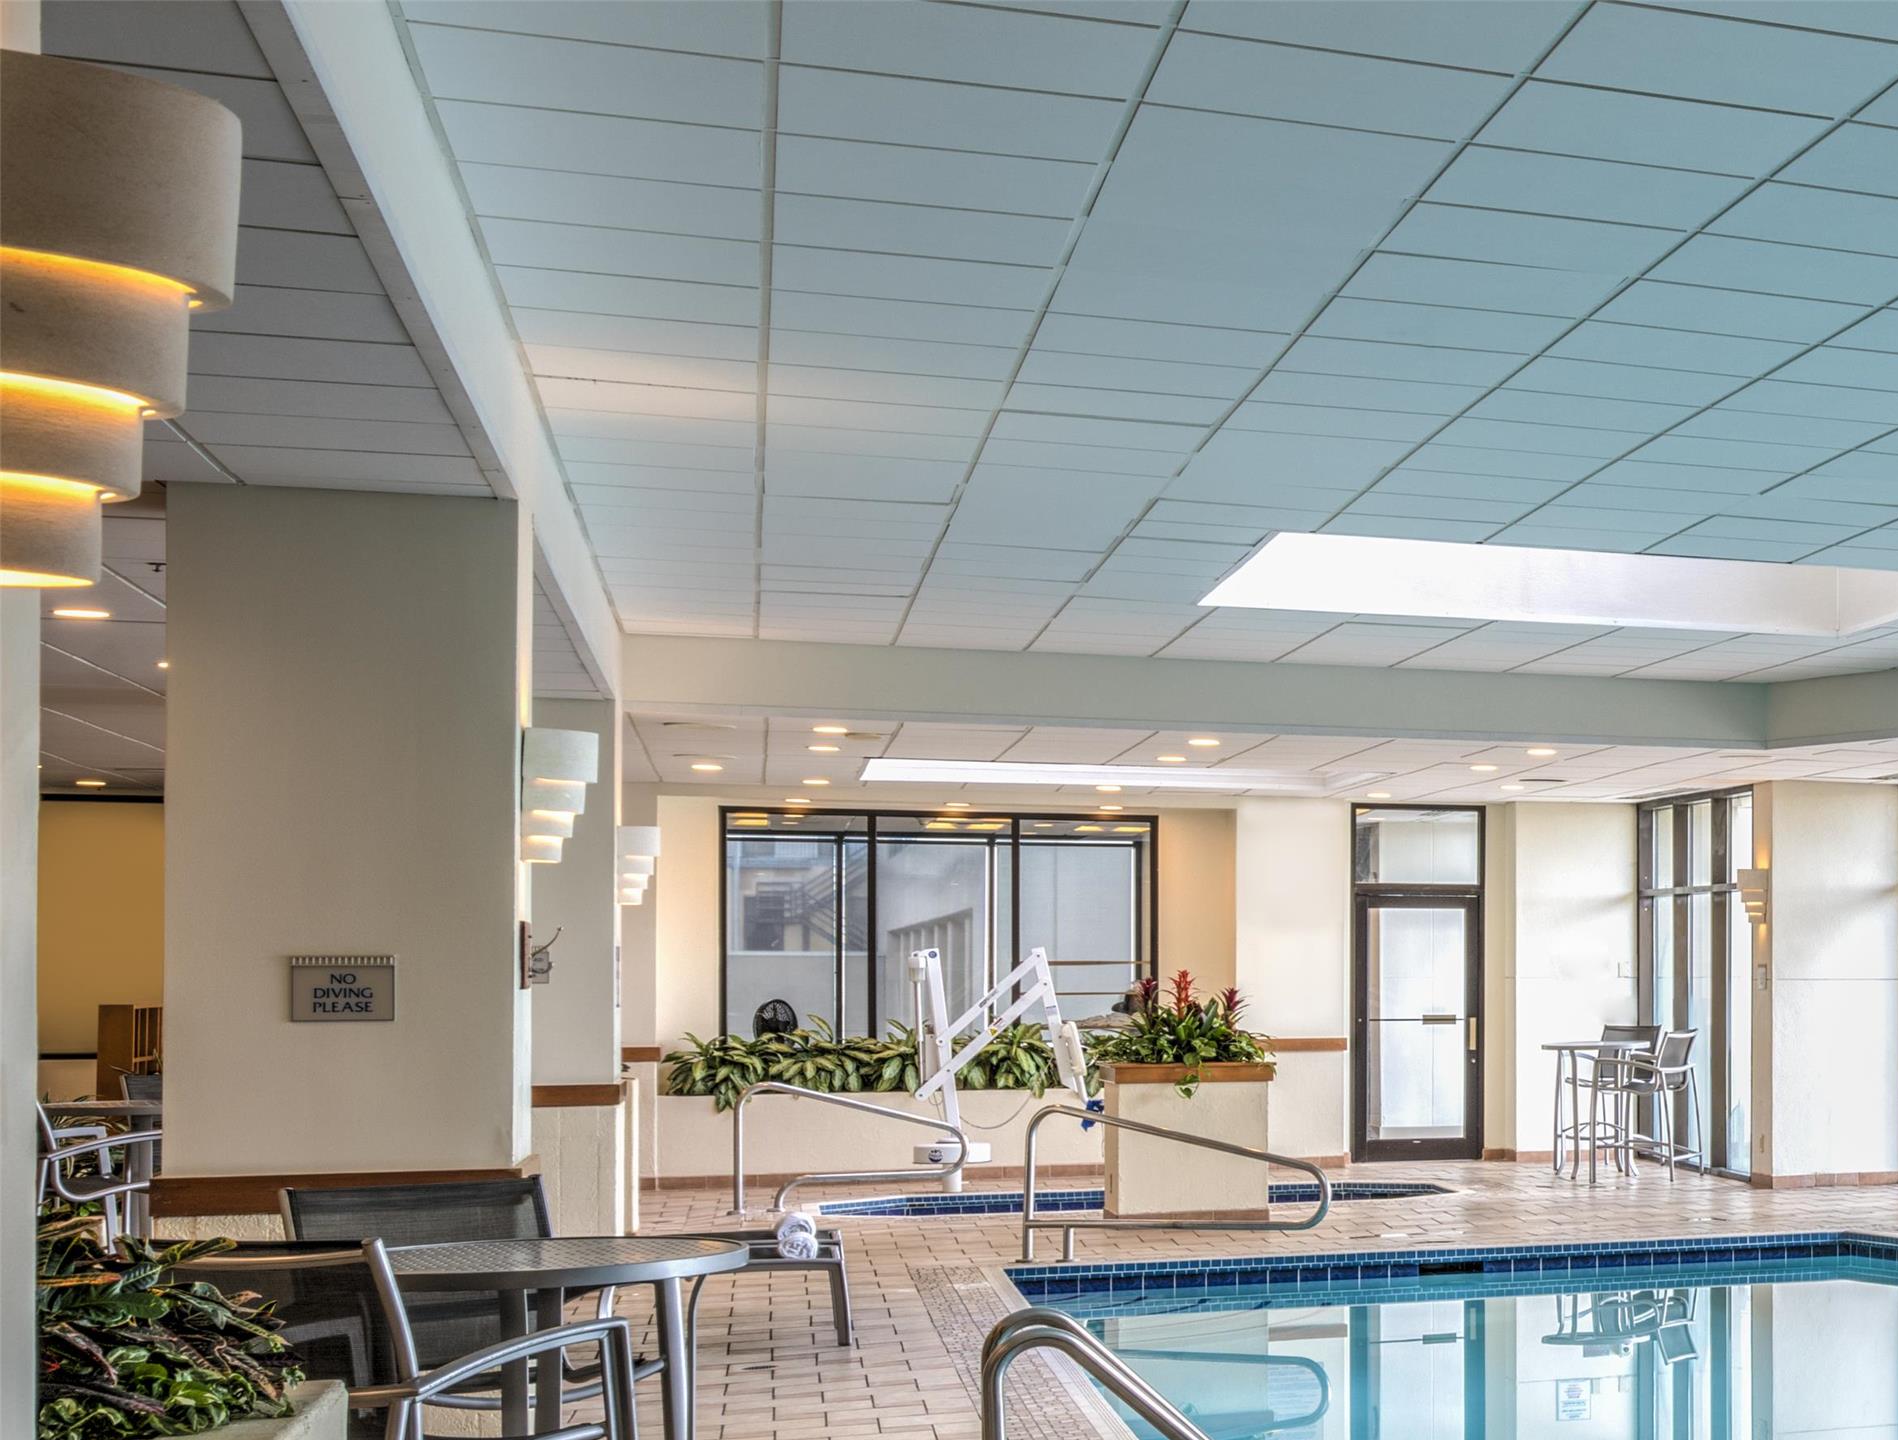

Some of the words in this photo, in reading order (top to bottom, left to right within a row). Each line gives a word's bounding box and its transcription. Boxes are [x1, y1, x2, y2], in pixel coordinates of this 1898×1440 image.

[330, 973, 357, 985] NO
[312, 987, 374, 999] DIVING
[312, 1001, 374, 1013] PLEASE
